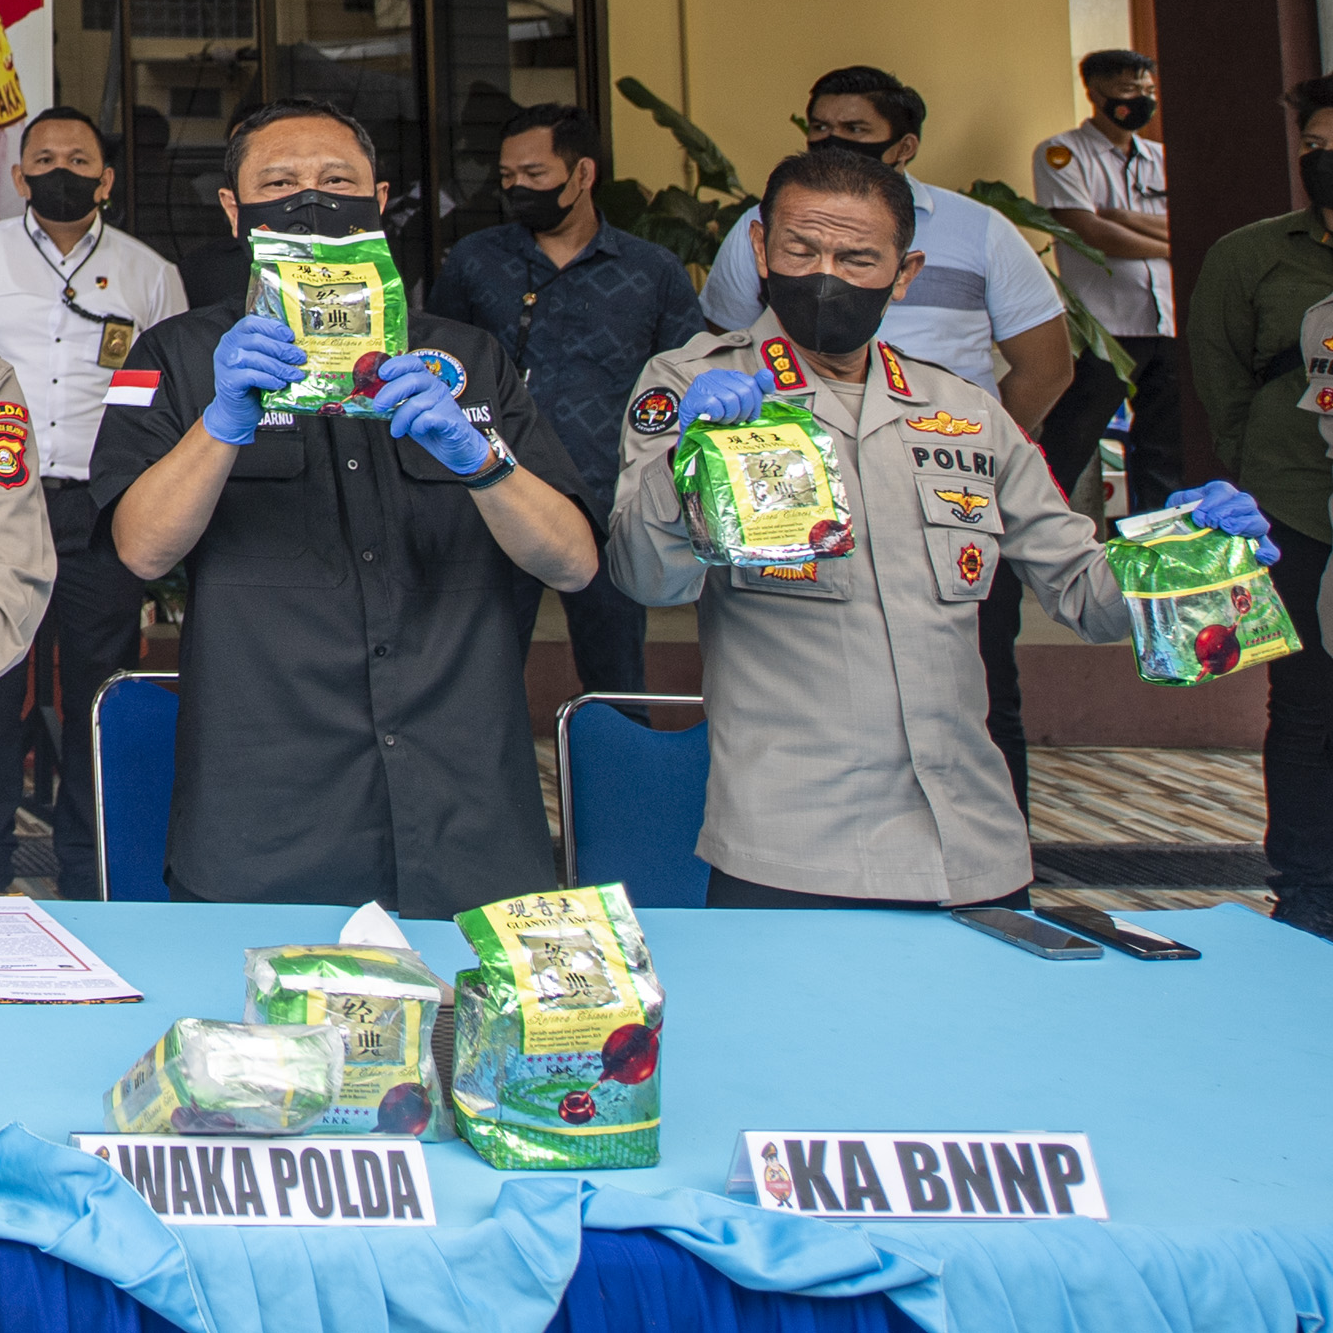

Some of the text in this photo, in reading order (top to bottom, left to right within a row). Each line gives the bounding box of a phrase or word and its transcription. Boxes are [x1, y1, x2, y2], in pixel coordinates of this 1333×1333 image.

[292, 273, 367, 283] GUANYINWANG
[912, 447, 995, 478] POLRI
[507, 897, 575, 919] 观音王
[341, 999, 384, 1057] 经典
[527, 1006, 639, 1026] Refined Chinese Tea
[117, 1144, 425, 1221] WAKA POLDA
[784, 1139, 1084, 1215] KA BNNP
